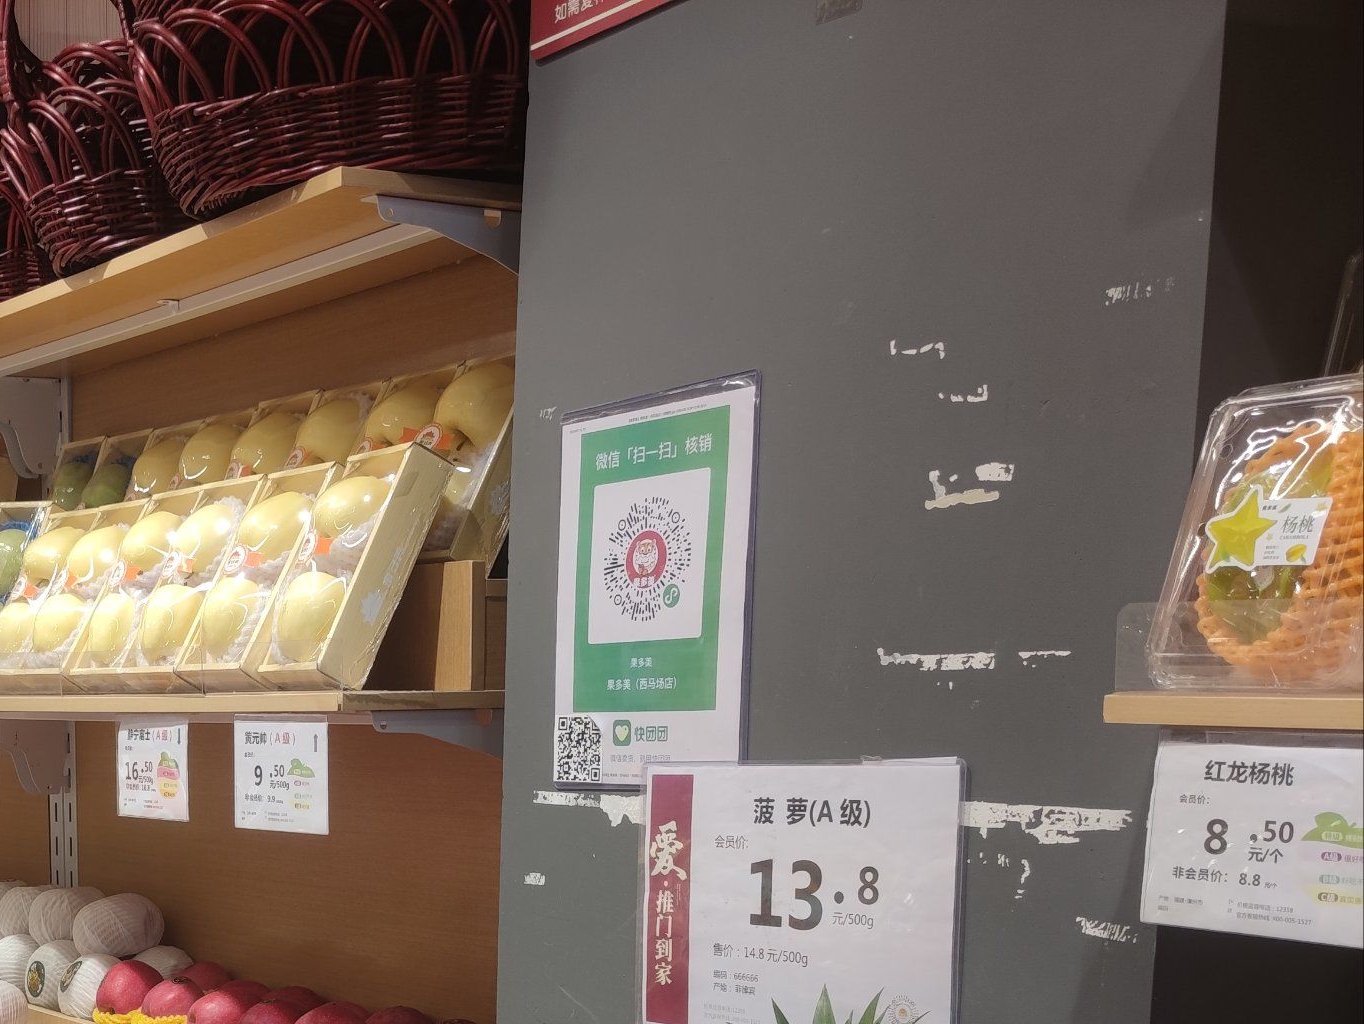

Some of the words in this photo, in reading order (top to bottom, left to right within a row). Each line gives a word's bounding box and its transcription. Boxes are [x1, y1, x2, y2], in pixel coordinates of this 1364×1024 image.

[1281, 515, 1316, 533] 杨桃
[629, 657, 653, 668] 果多美
[634, 725, 668, 742] 快团团
[1203, 759, 1295, 786] 红龙杨桃
[1248, 847, 1284, 863] 元/个
[1238, 872, 1261, 886] 8.8
[832, 911, 874, 929] 元/500g
[767, 948, 808, 968] 元/500g
